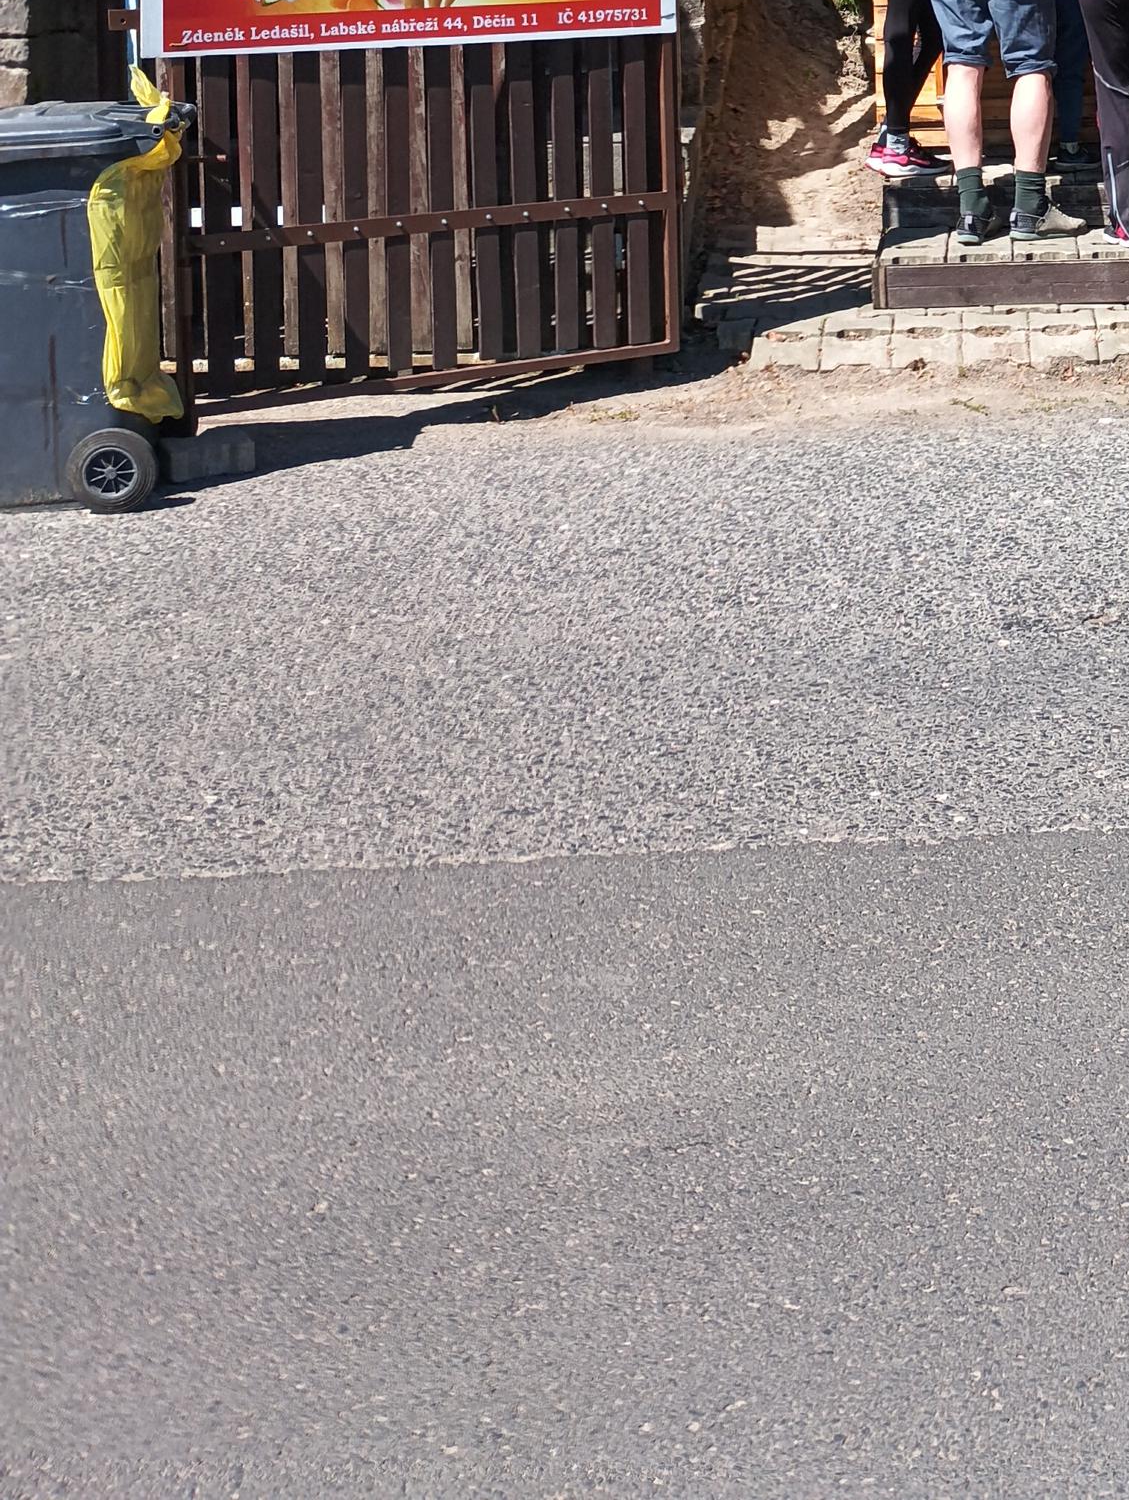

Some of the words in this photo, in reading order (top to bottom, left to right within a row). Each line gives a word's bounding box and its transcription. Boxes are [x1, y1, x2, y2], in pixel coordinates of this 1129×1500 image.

[182, 27, 245, 44] Zdeněk
[250, 23, 315, 40] Ledašil,
[320, 19, 376, 36] Labské
[381, 16, 439, 33] nábřeží
[443, 17, 468, 32] 44,
[472, 14, 516, 29] Děčín
[521, 13, 539, 26] 11
[557, 7, 574, 25] IČ
[577, 7, 648, 23] 41975731
